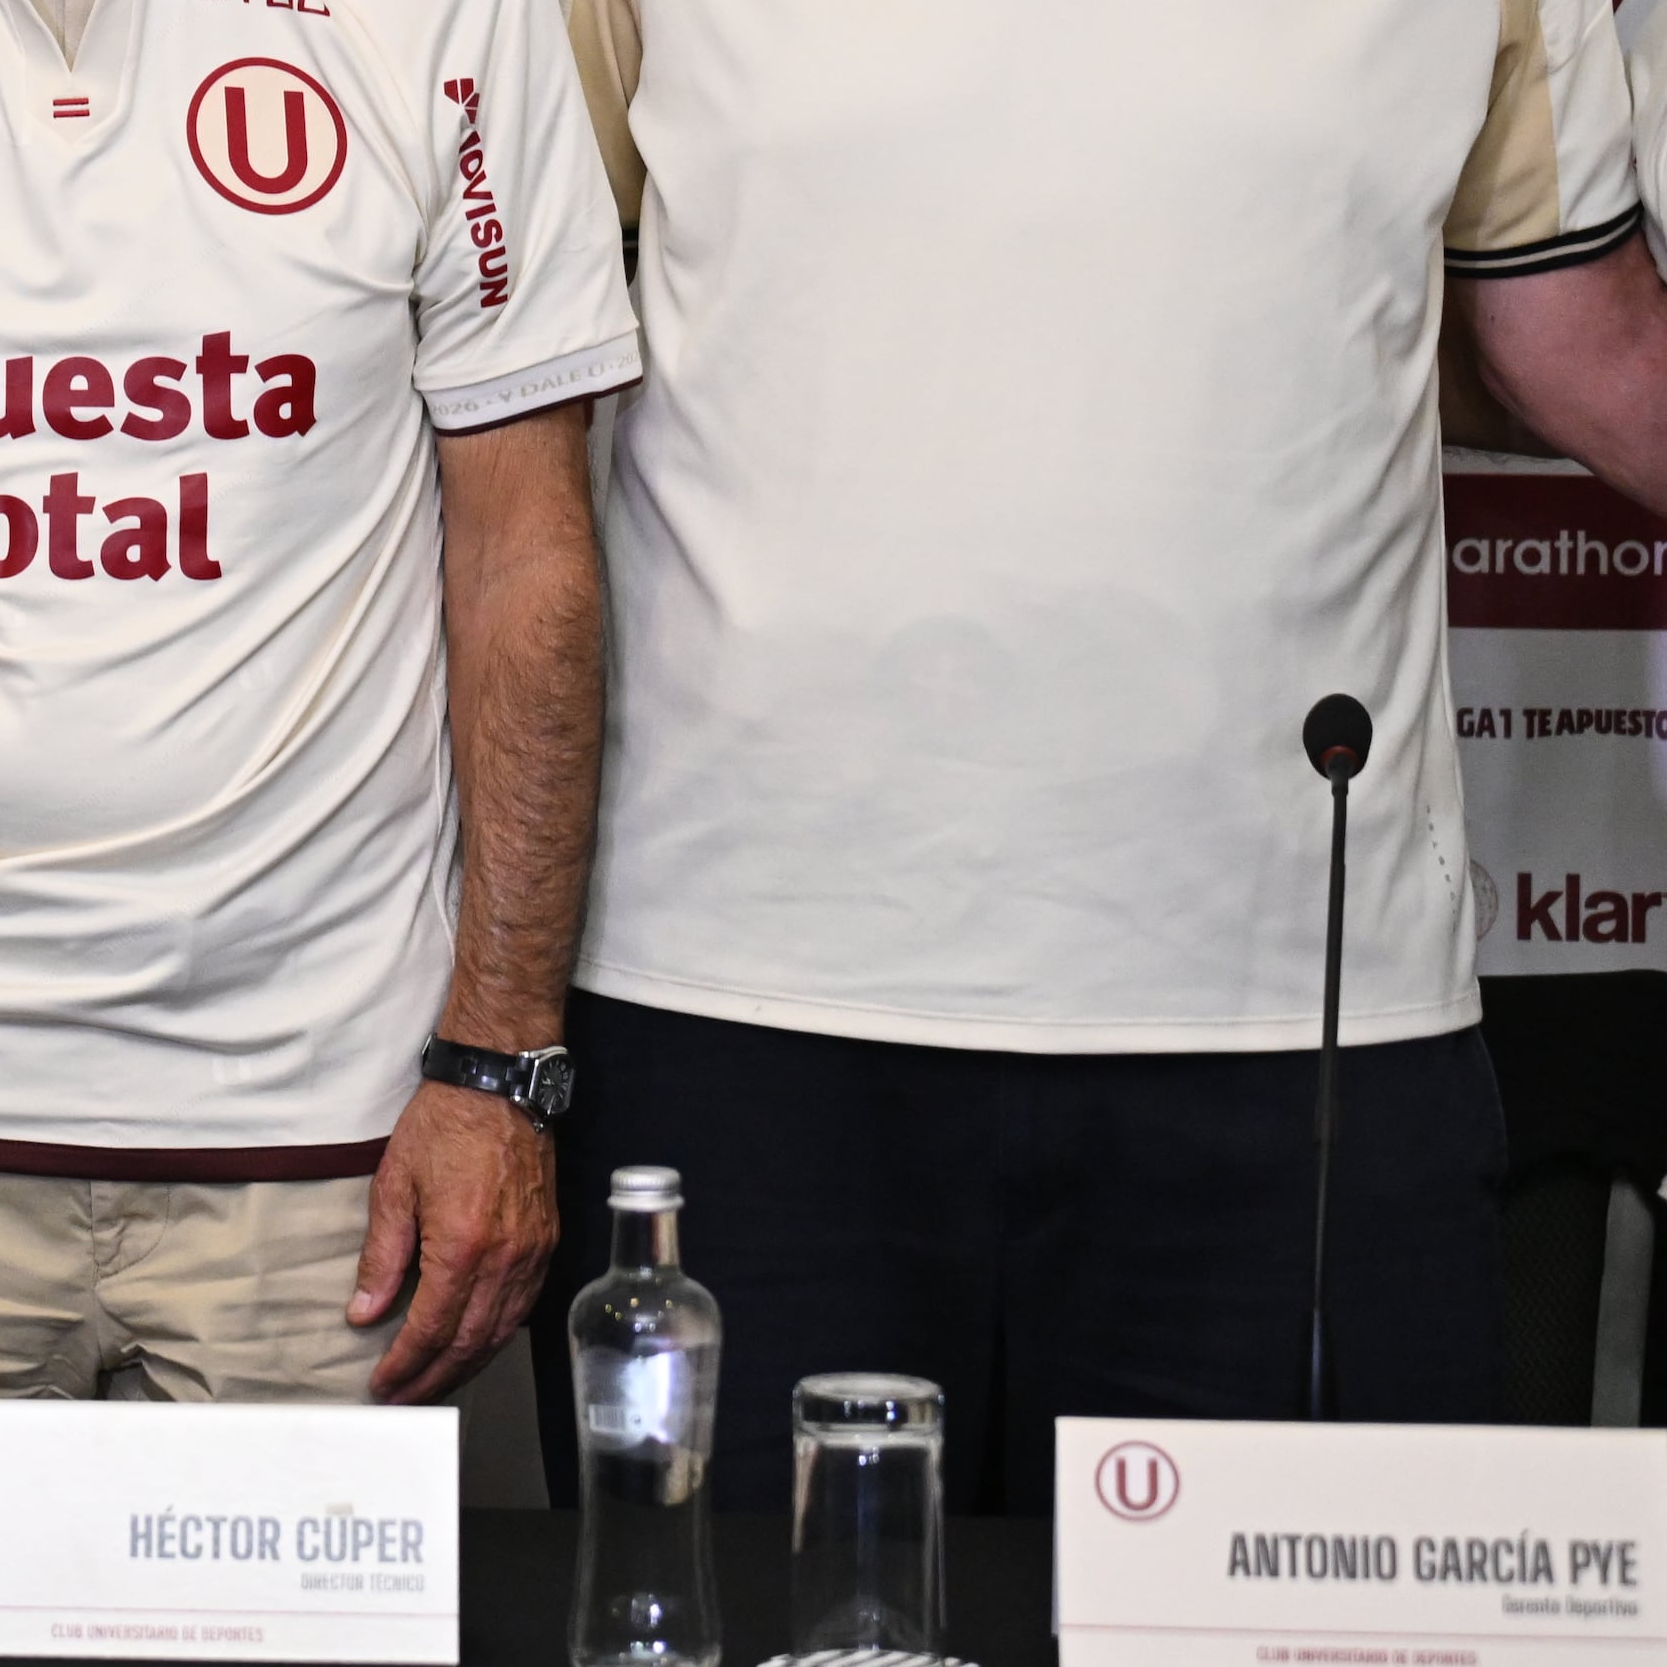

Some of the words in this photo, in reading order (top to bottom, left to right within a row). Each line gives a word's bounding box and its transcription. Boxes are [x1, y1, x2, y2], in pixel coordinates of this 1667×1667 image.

[224, 85, 309, 195] U
[1452, 530, 1667, 577] aratho
[1114, 1457, 1159, 1512] U
[129, 1505, 282, 1562] HÉCTOR
[1226, 1531, 1398, 1583] ANTONIO
[1411, 1528, 1556, 1586] GARCÍA
[1567, 1538, 1639, 1588] PYE
